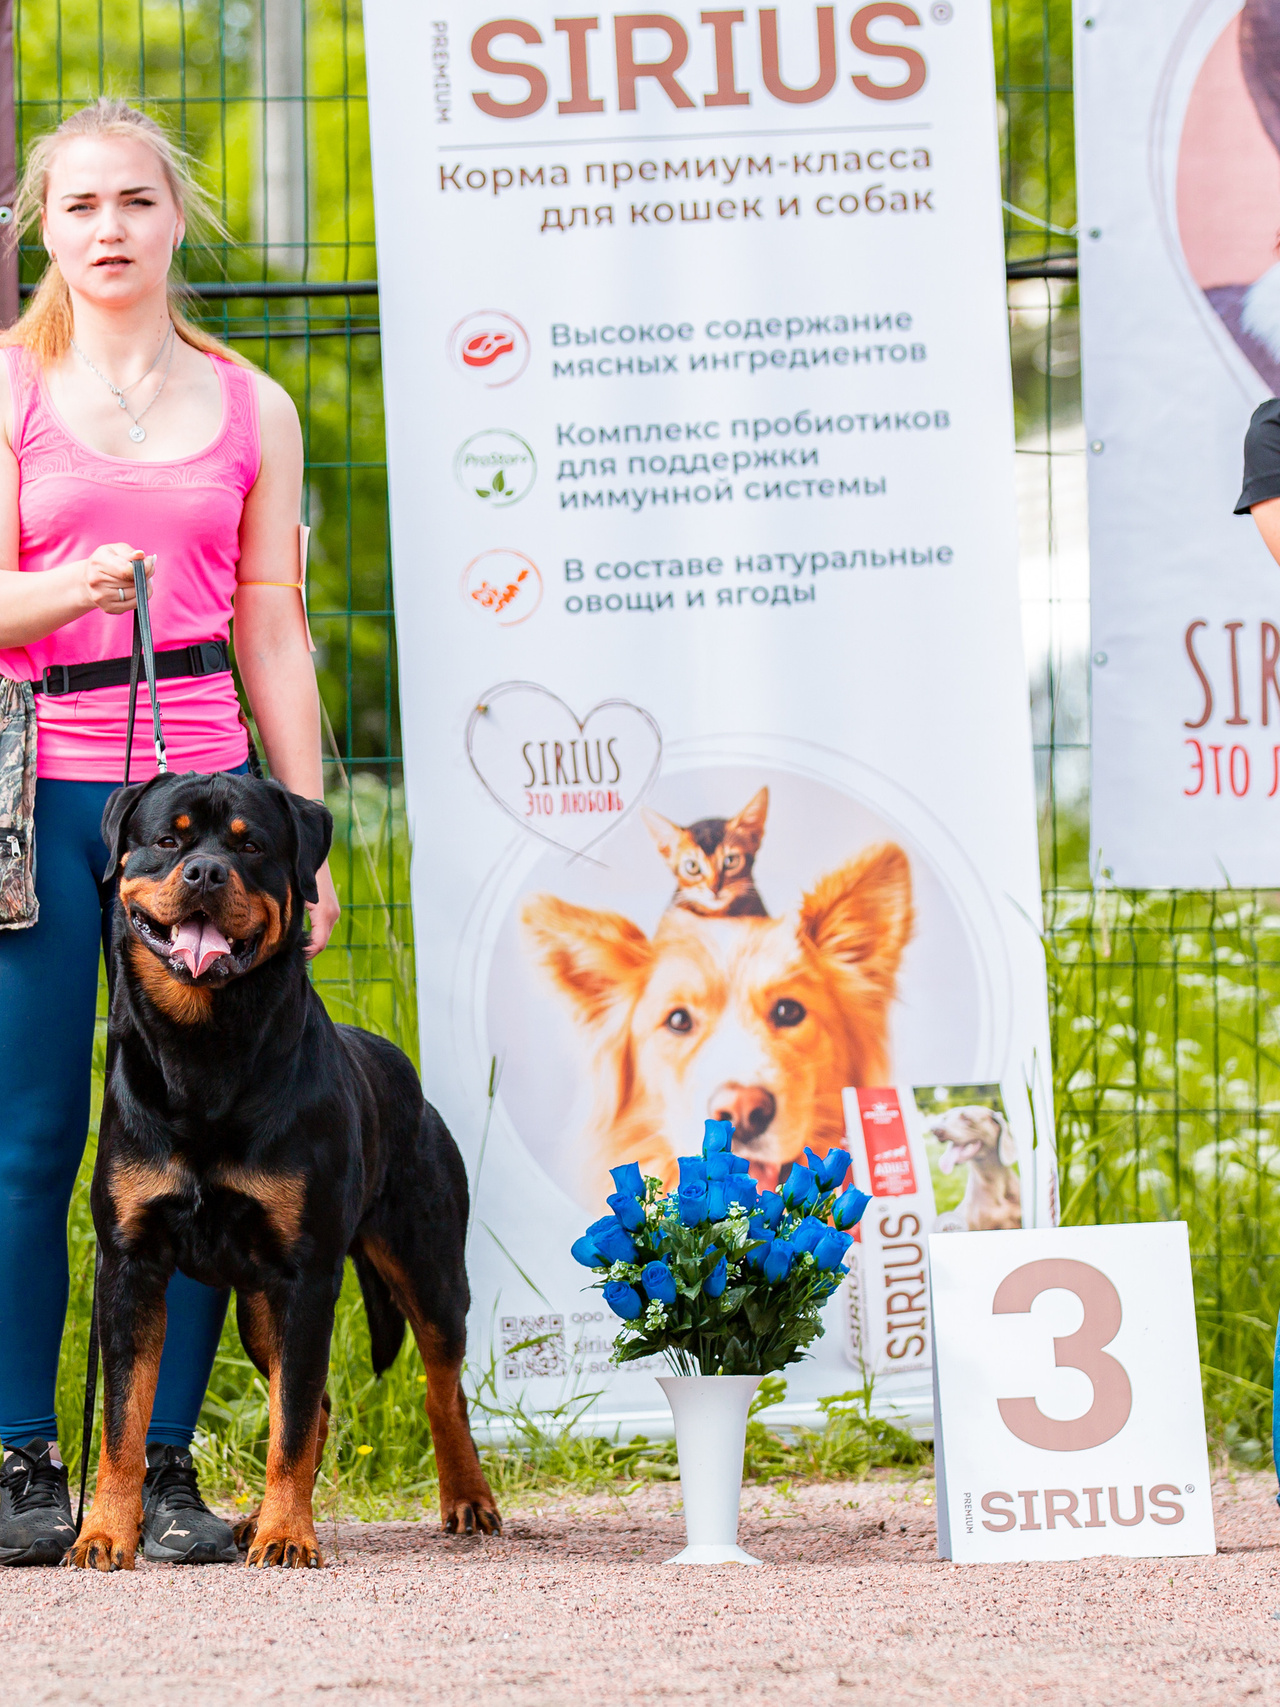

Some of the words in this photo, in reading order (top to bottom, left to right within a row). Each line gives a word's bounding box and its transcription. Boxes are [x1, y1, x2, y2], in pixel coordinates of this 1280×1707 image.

[431, 20, 451, 124] PREMIUM
[439, 163, 569, 196] Корма
[585, 147, 933, 189] премиум-класса
[539, 205, 615, 234] для
[630, 198, 763, 225] кошек
[778, 198, 800, 217] и
[815, 183, 935, 216] собак
[550, 321, 695, 348] Высокое
[705, 310, 914, 341] содержание
[552, 354, 679, 378] мясных
[689, 342, 928, 375] ингредиентов
[556, 420, 720, 447] Комплекс
[730, 409, 951, 443] пробиотиков
[556, 457, 617, 482] для
[627, 447, 820, 476] поддержки
[559, 478, 733, 512] иммунной
[744, 474, 888, 500] системы
[563, 558, 586, 583] В
[594, 556, 724, 582] составе
[735, 545, 955, 578] натуральные
[564, 591, 675, 614] овощи
[686, 591, 706, 608] и
[716, 582, 817, 608] ягоды
[521, 737, 622, 789] SIRIUS
[1183, 738, 1251, 797] ЭТО
[524, 789, 554, 816] ЭТО
[560, 789, 625, 815] ЛЮБОВЬ
[991, 1257, 1134, 1453] 3
[963, 1492, 974, 1534] PREMIUM
